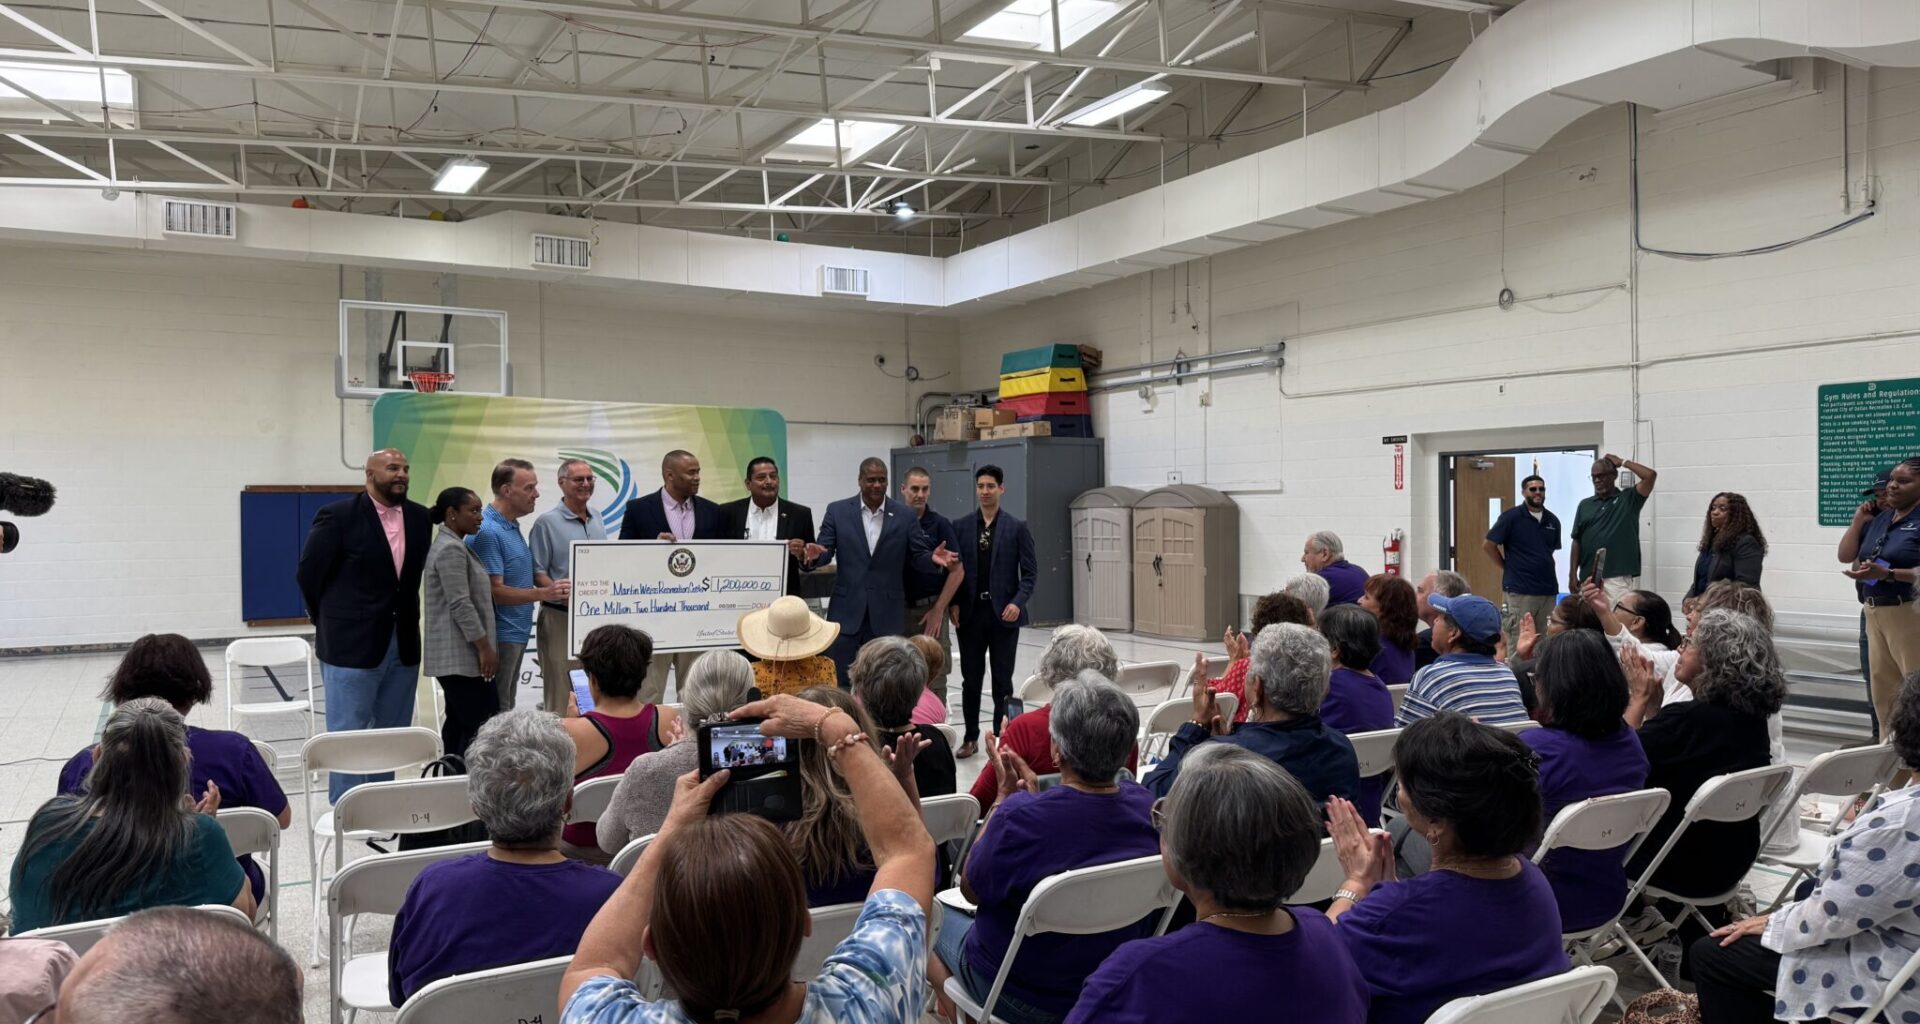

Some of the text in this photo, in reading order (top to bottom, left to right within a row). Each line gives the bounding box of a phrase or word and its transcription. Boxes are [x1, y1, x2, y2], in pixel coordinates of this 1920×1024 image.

[613, 581, 639, 596] Martin
[580, 598, 709, 616] One Million Two Hundred Thousand
[412, 812, 430, 824] D-4
